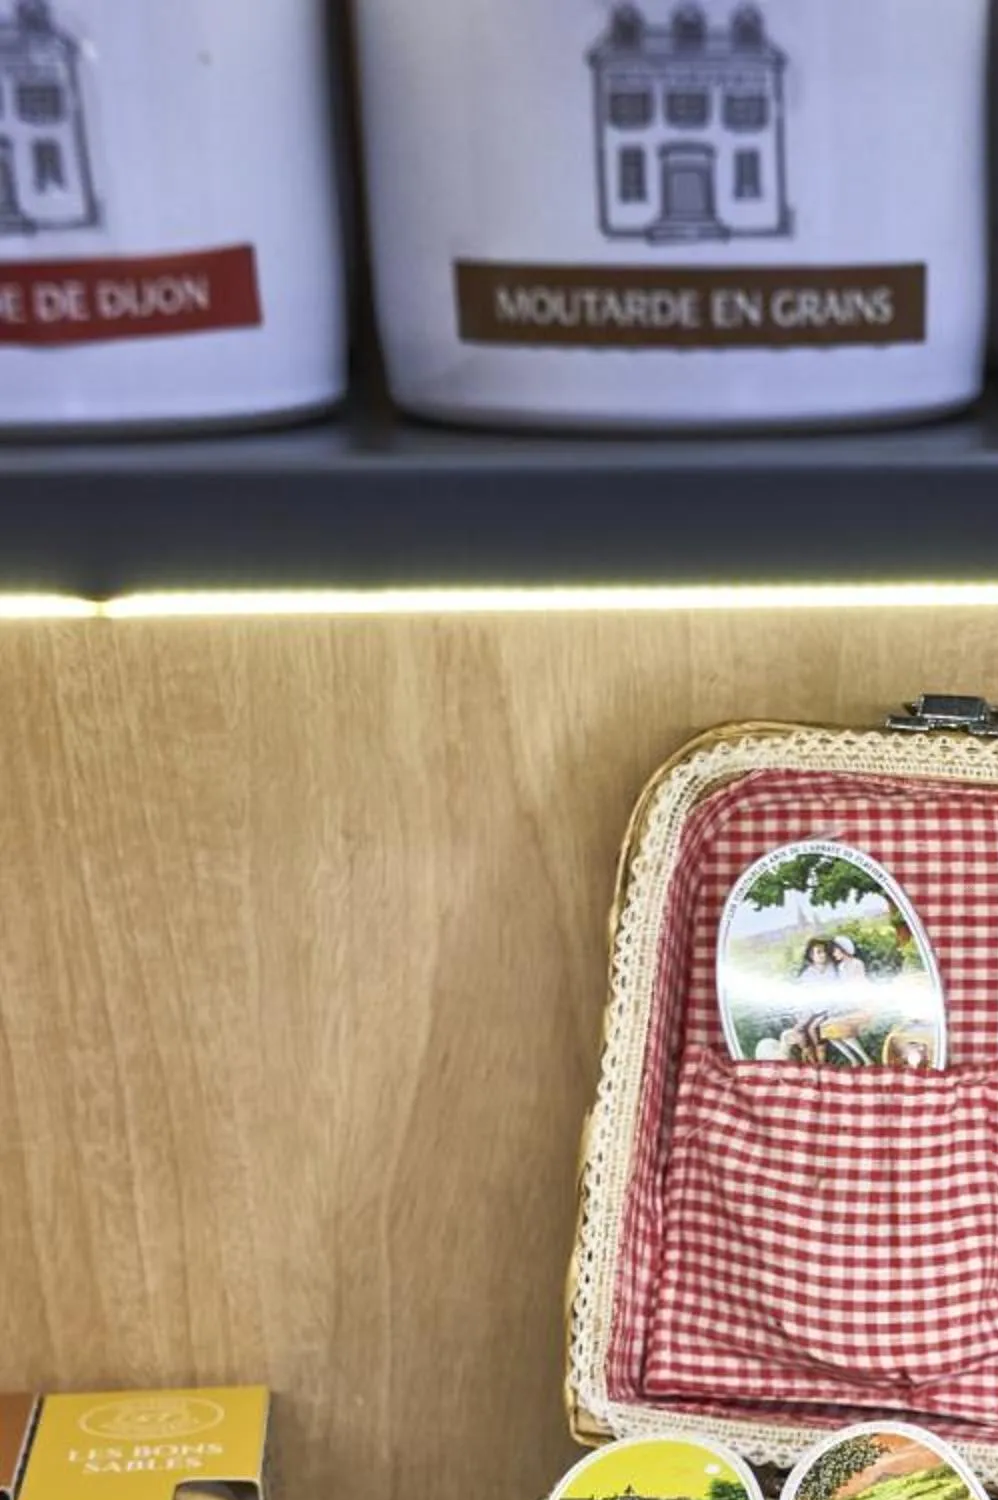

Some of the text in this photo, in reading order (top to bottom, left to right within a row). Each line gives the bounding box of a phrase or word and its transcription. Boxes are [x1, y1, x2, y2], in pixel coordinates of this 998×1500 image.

[33, 279, 90, 321] DE
[96, 273, 210, 319] DIJON
[495, 285, 894, 328] MOUTARDE EN GRAINS
[134, 1443, 224, 1458] BONS
